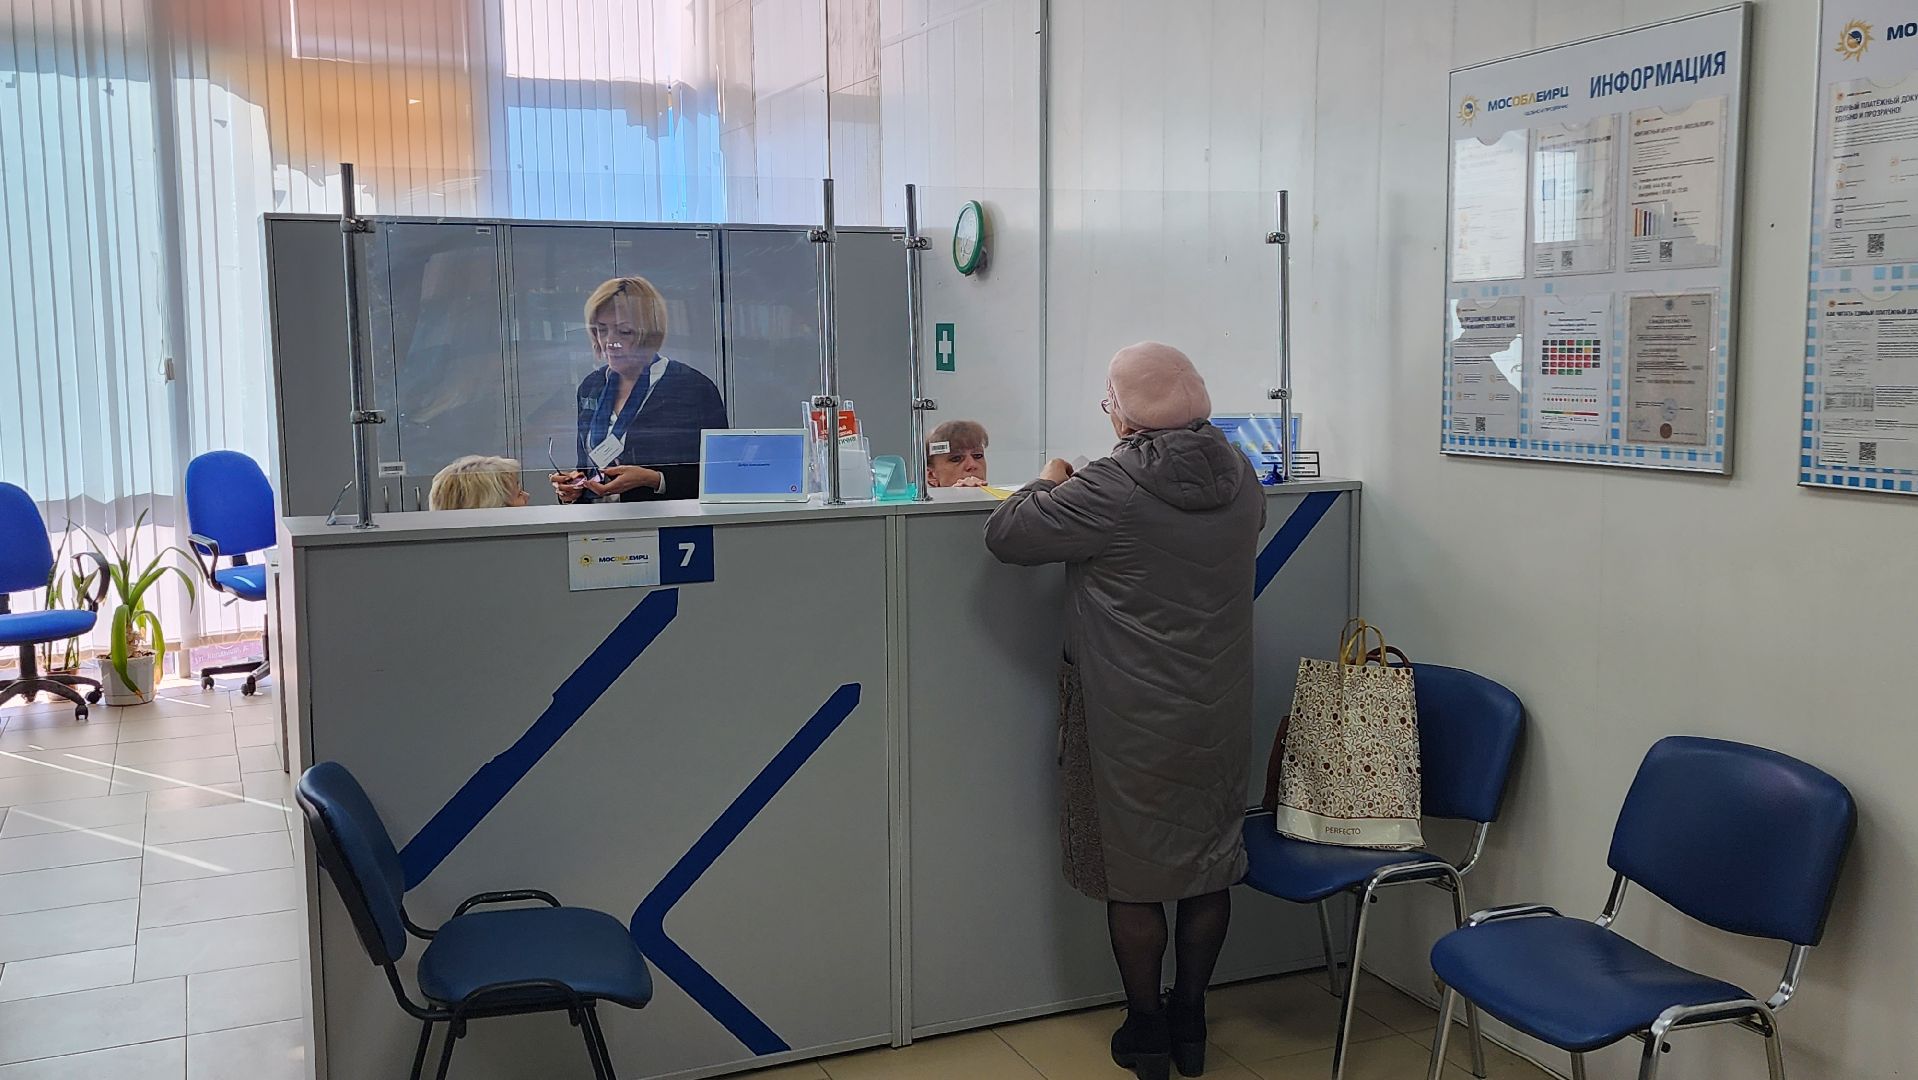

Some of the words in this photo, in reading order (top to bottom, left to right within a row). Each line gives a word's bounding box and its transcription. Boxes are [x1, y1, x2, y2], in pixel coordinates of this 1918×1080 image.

[1887, 22, 1918, 40] МО
[1589, 50, 1727, 99] ИНФОРМАЦИЯ
[1487, 85, 1569, 112] МОСОБЛЕИРЦ
[678, 542, 696, 567] 7
[1325, 826, 1361, 835] PERFECTO
